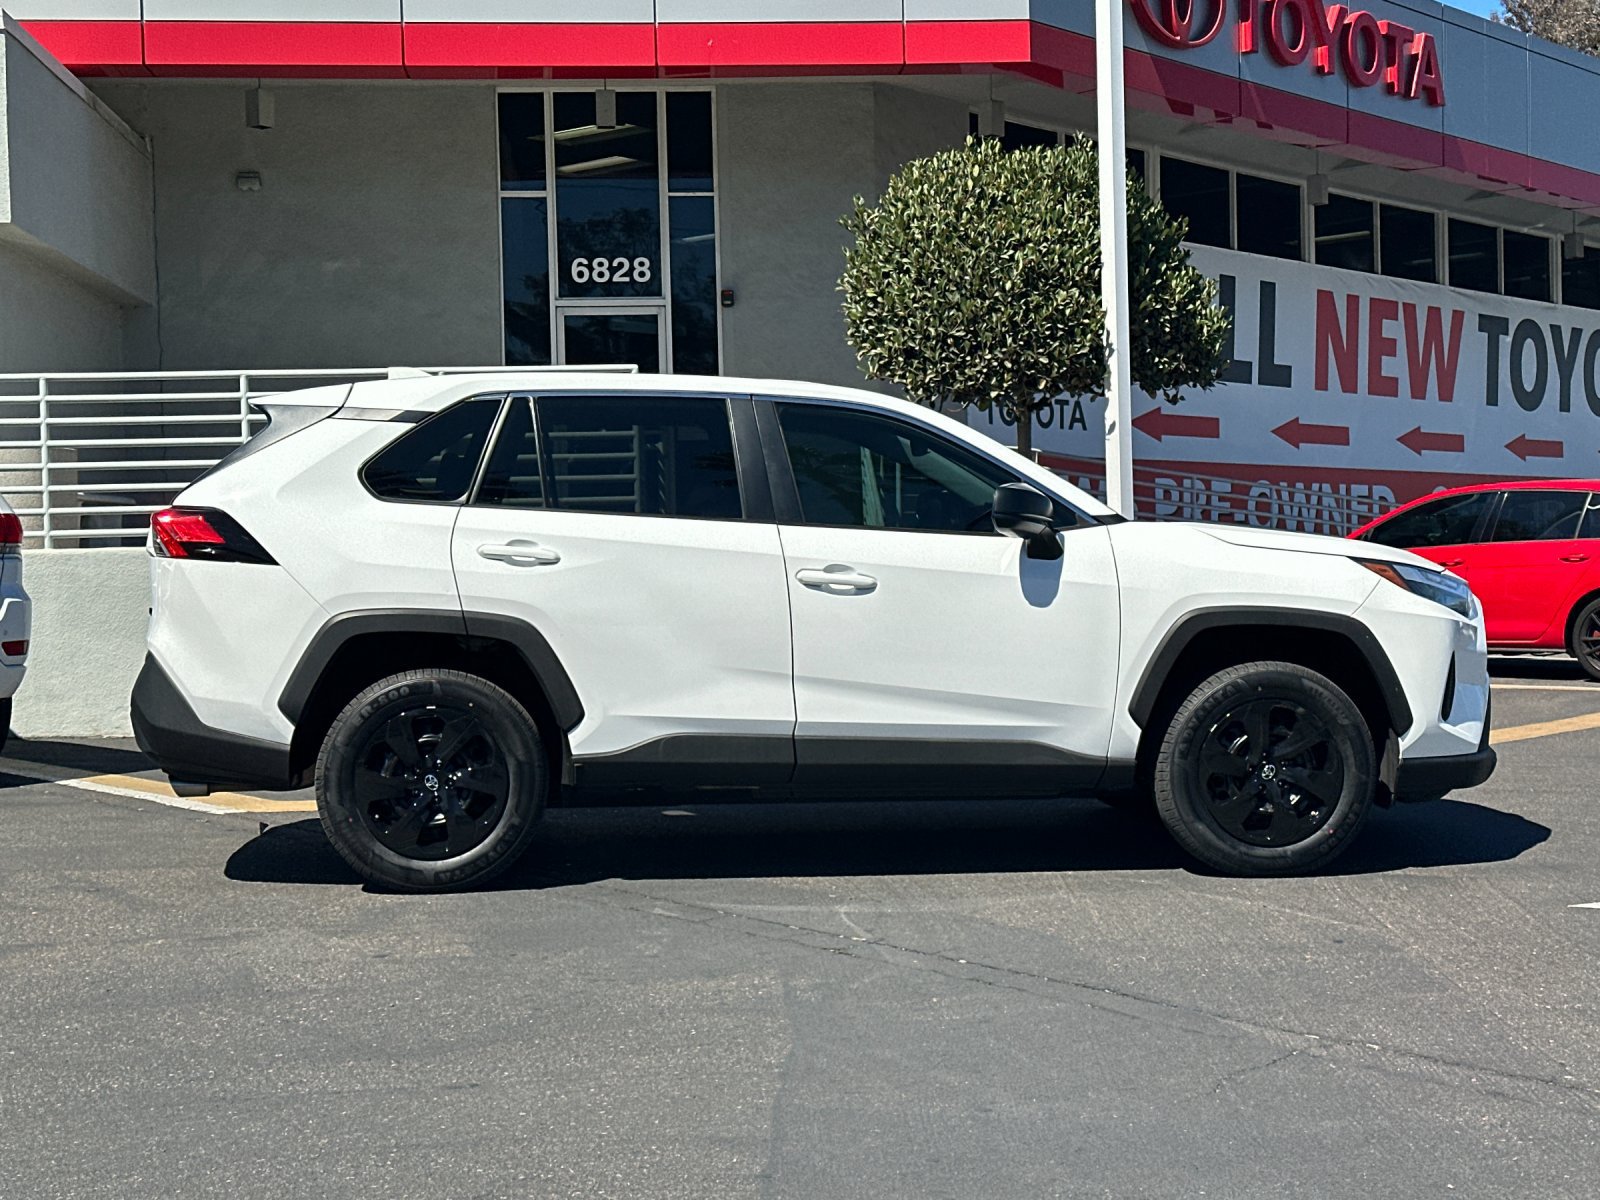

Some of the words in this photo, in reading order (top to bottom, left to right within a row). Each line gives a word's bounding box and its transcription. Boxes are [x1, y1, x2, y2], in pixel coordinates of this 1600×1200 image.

[571, 256, 651, 283] 6828
[1214, 274, 1292, 388] LL
[1314, 289, 1465, 402] NEW
[986, 391, 1088, 431] TOOTA
